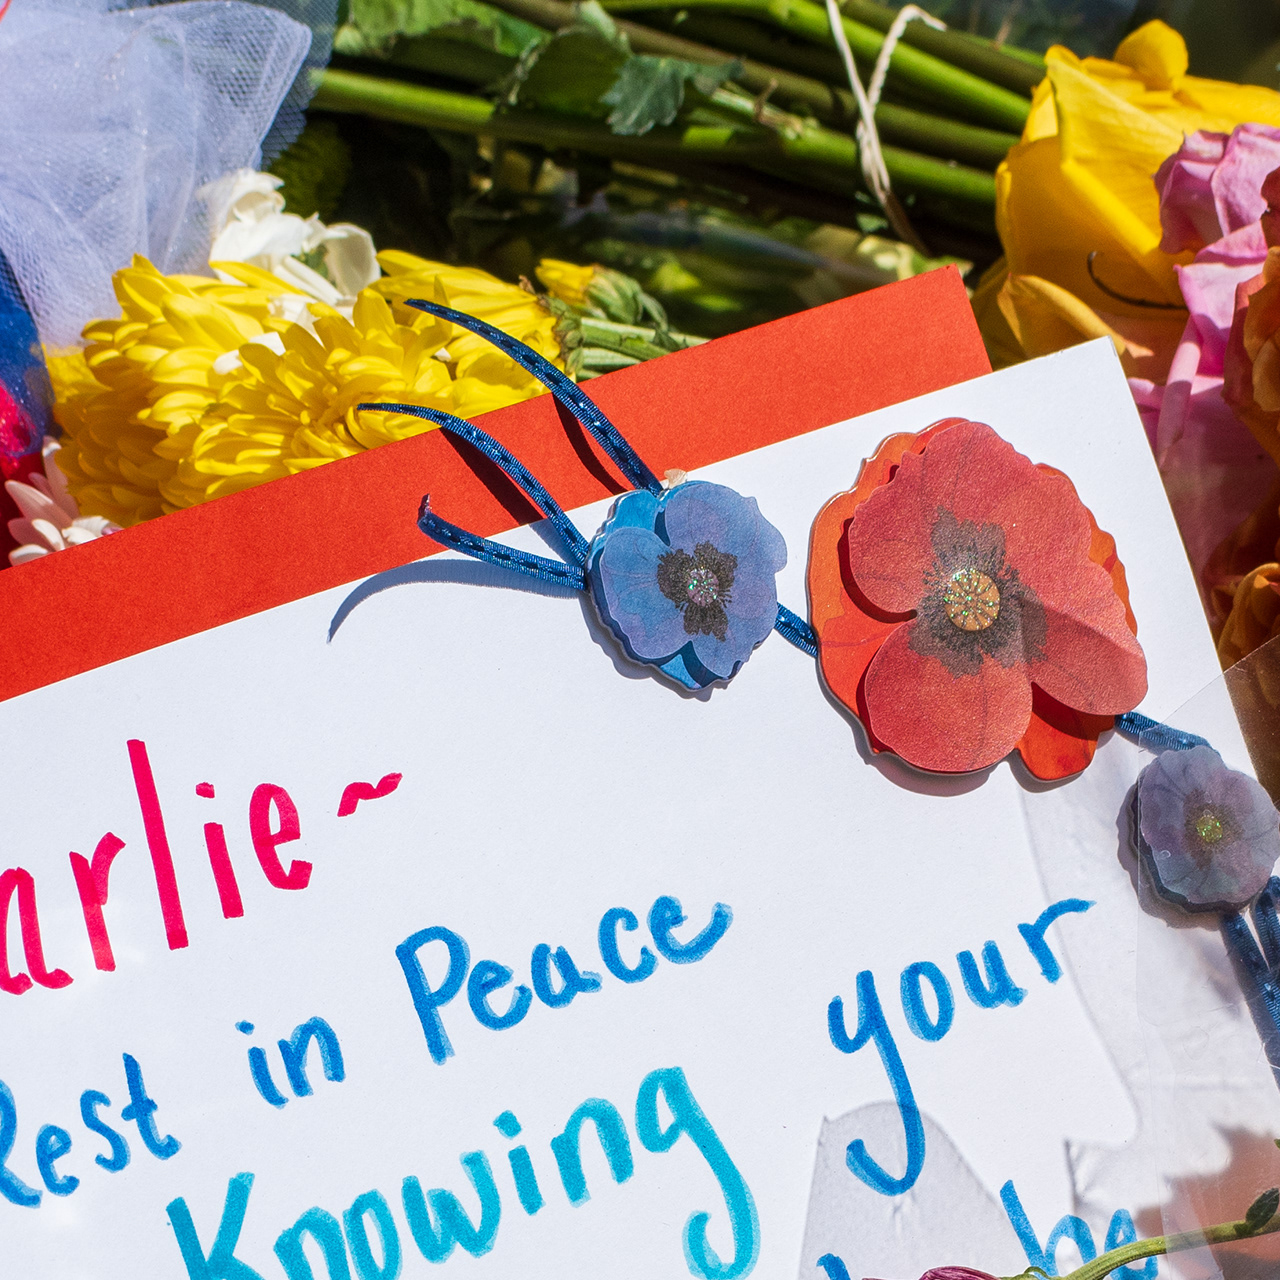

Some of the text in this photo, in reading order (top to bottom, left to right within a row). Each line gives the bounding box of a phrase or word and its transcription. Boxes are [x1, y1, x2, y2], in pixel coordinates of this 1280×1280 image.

[236, 1016, 347, 1109] in
[394, 894, 734, 1065] Peace
[827, 898, 1097, 1198] your
